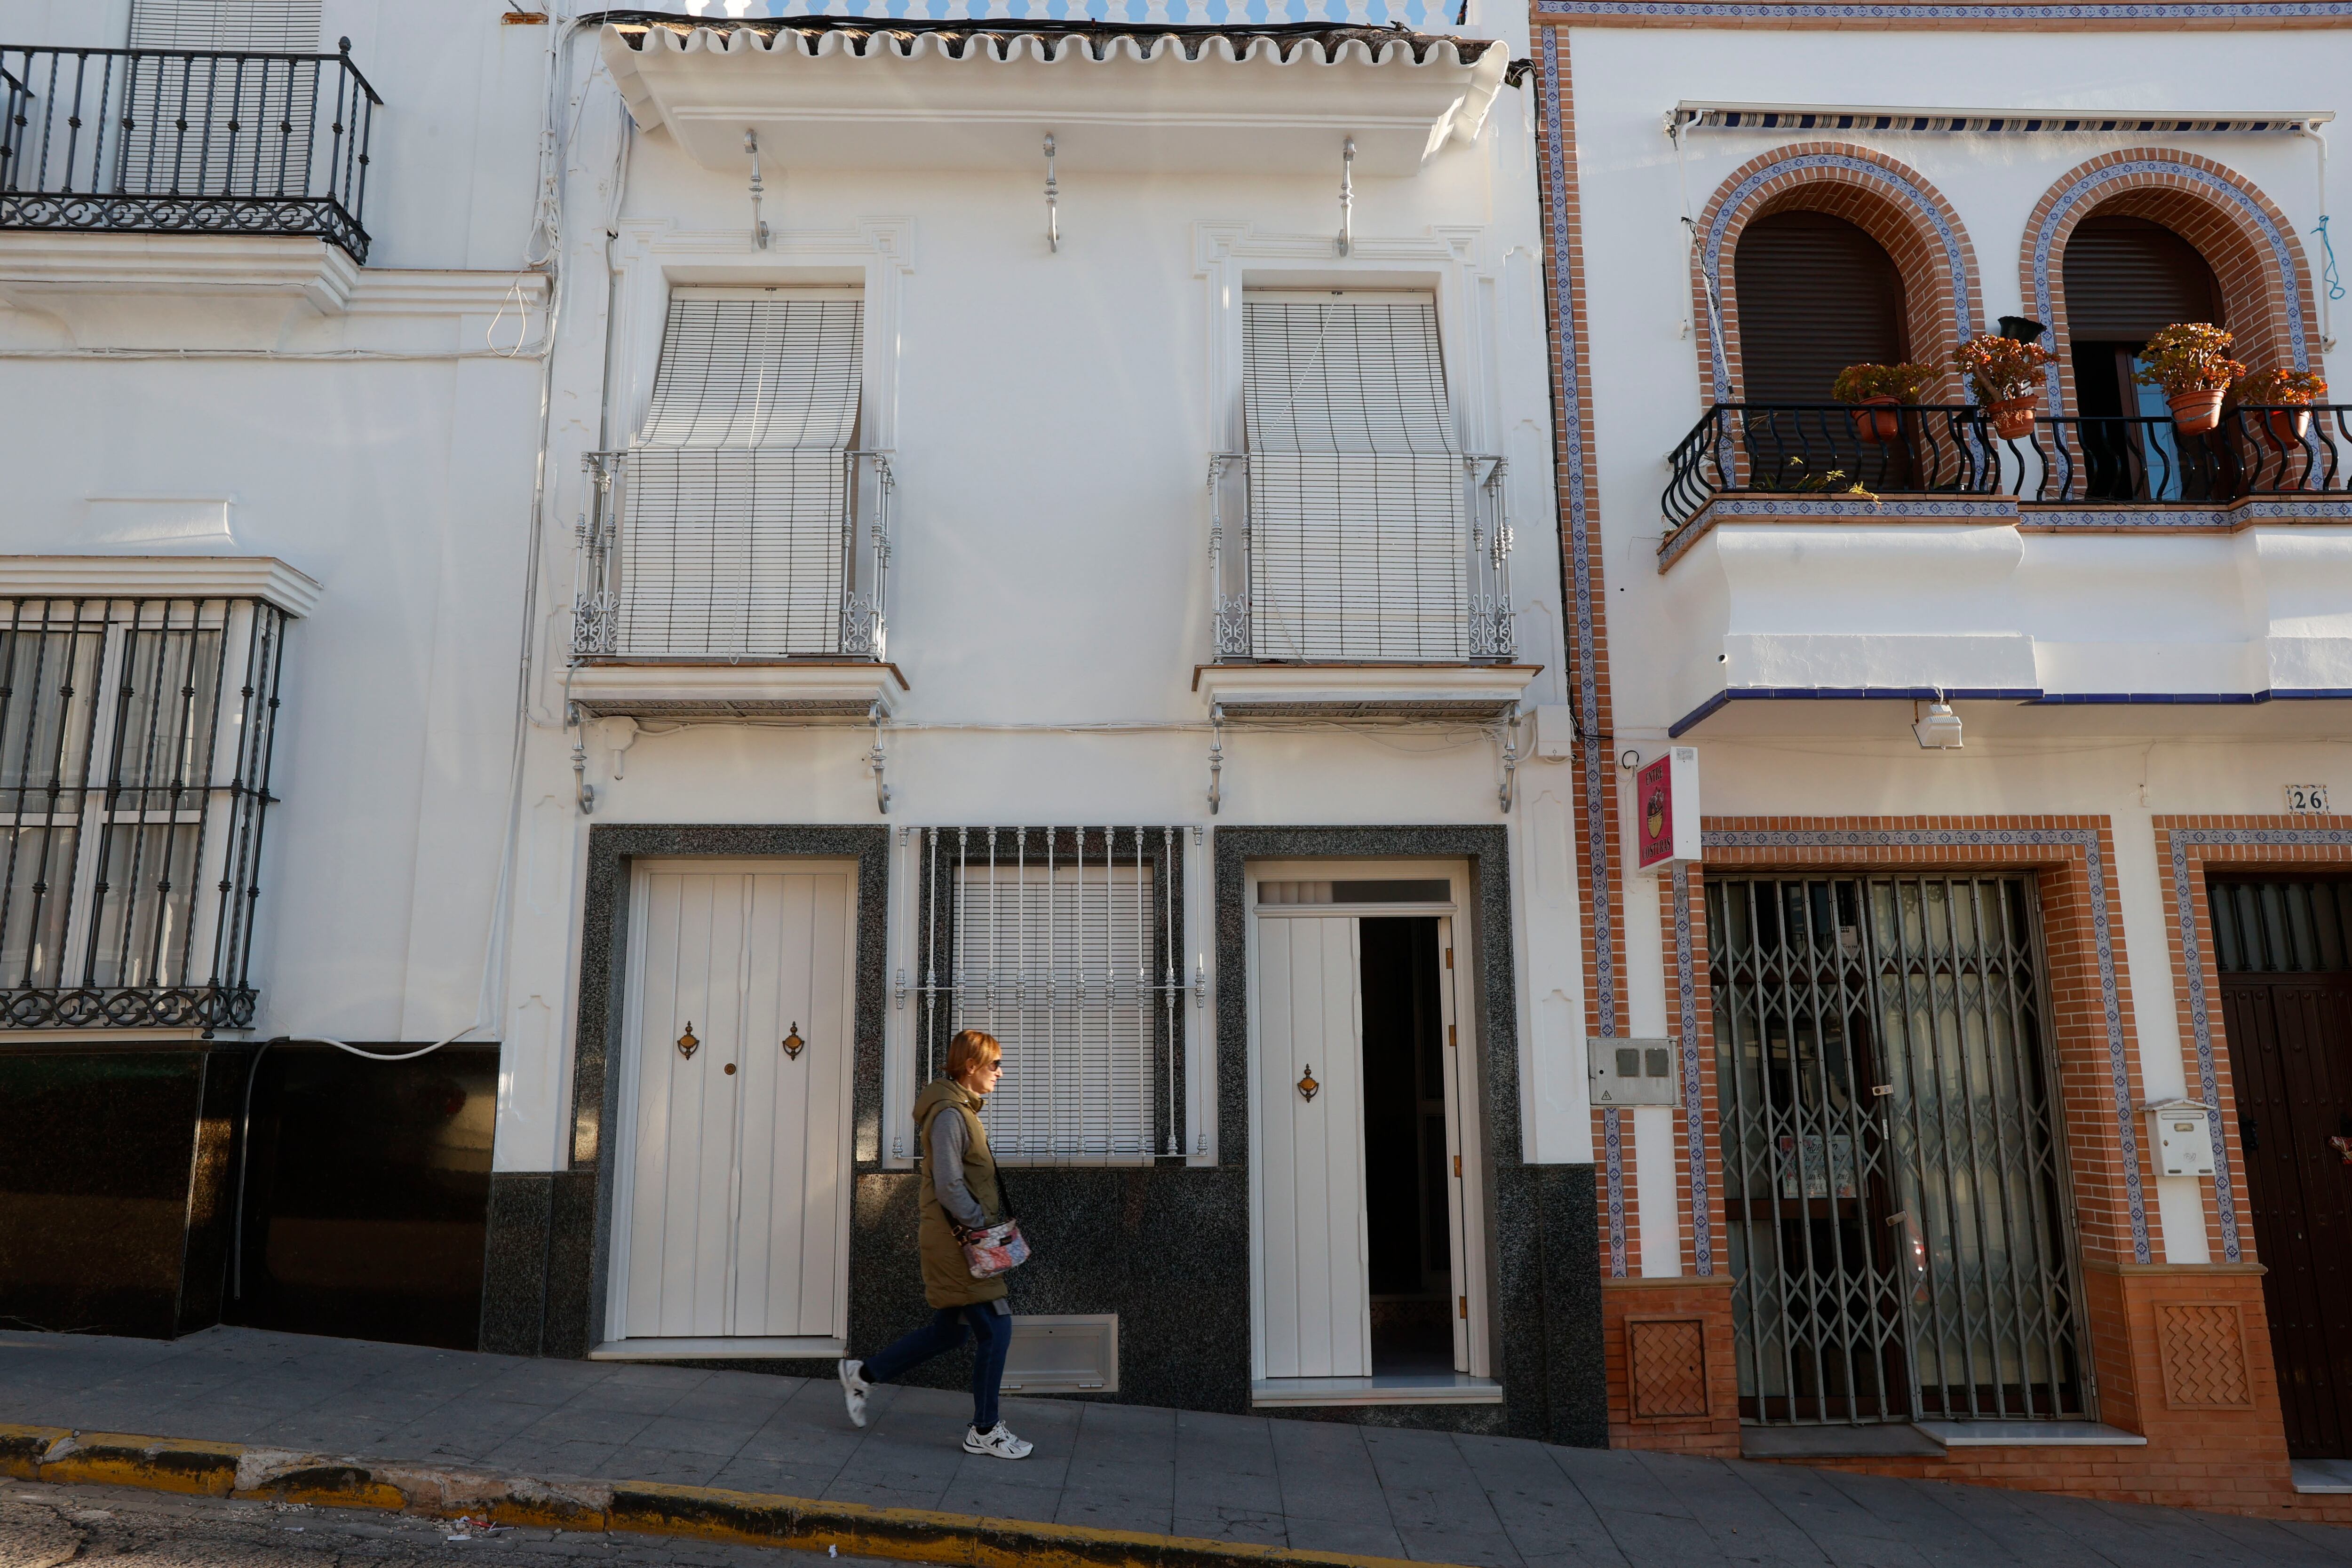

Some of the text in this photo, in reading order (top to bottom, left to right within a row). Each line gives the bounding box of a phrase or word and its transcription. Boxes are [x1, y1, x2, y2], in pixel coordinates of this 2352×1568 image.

[1646, 764, 1663, 786] ENTRE
[2294, 791, 2322, 809] 26
[1642, 836, 1671, 860] COSTURAS
